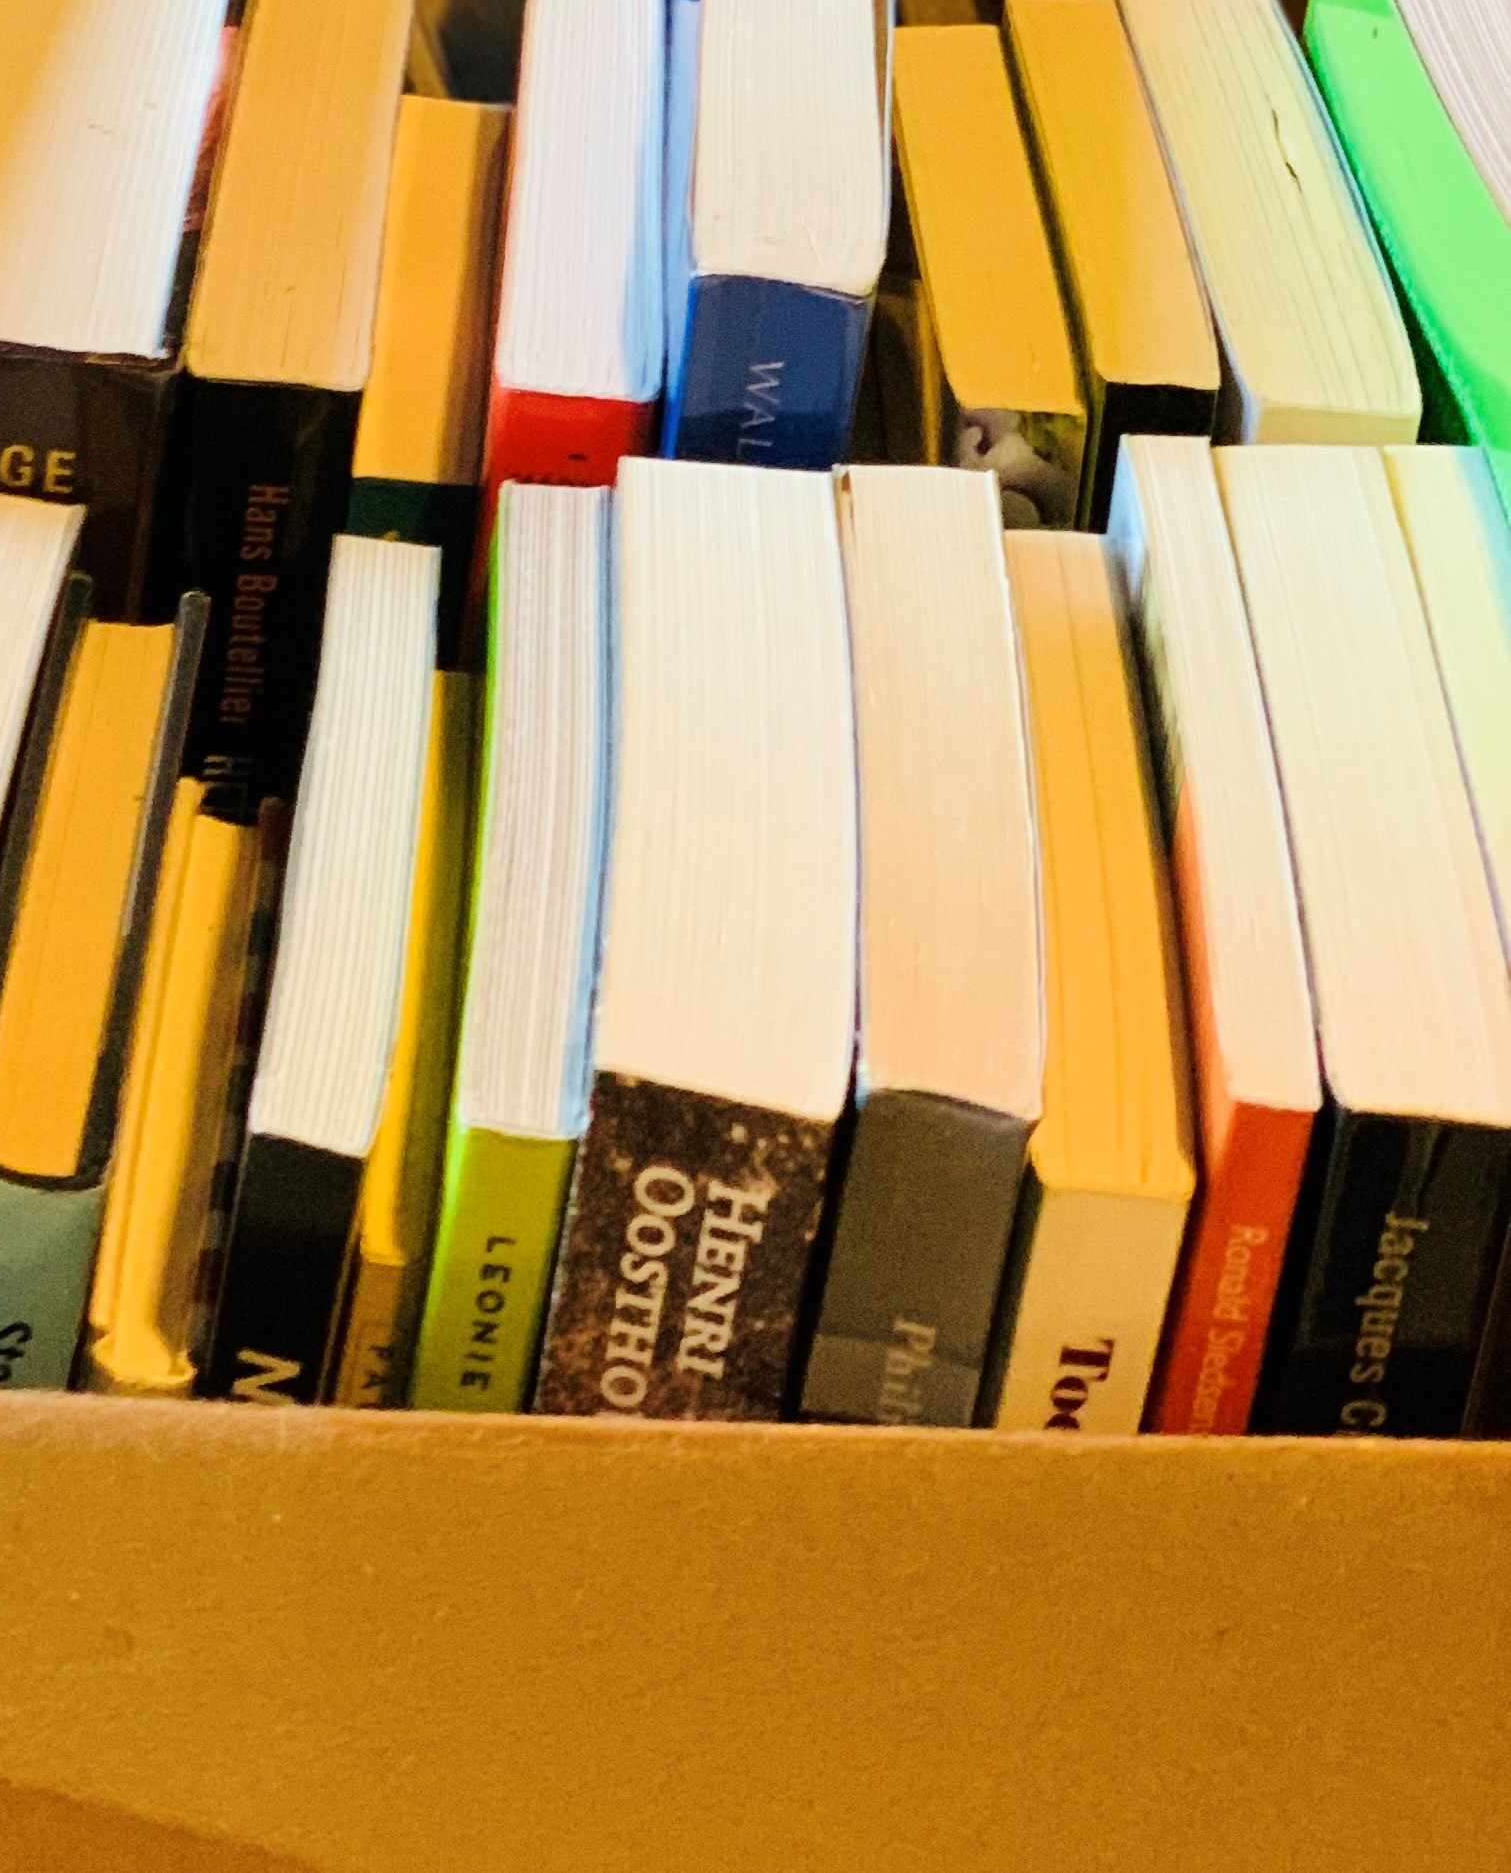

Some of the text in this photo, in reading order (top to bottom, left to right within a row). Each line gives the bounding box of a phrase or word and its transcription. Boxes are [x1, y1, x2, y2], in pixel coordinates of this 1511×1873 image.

[737, 360, 786, 456] WAL
[243, 484, 288, 560] Hans
[218, 574, 277, 725] Boutellier
[461, 1235, 516, 1391] LEONIE
[600, 1165, 695, 1408] OOSTHO
[678, 1178, 772, 1380] HENRI
[1214, 1225, 1268, 1323] Ronald
[1355, 1210, 1430, 1384] Jacques
